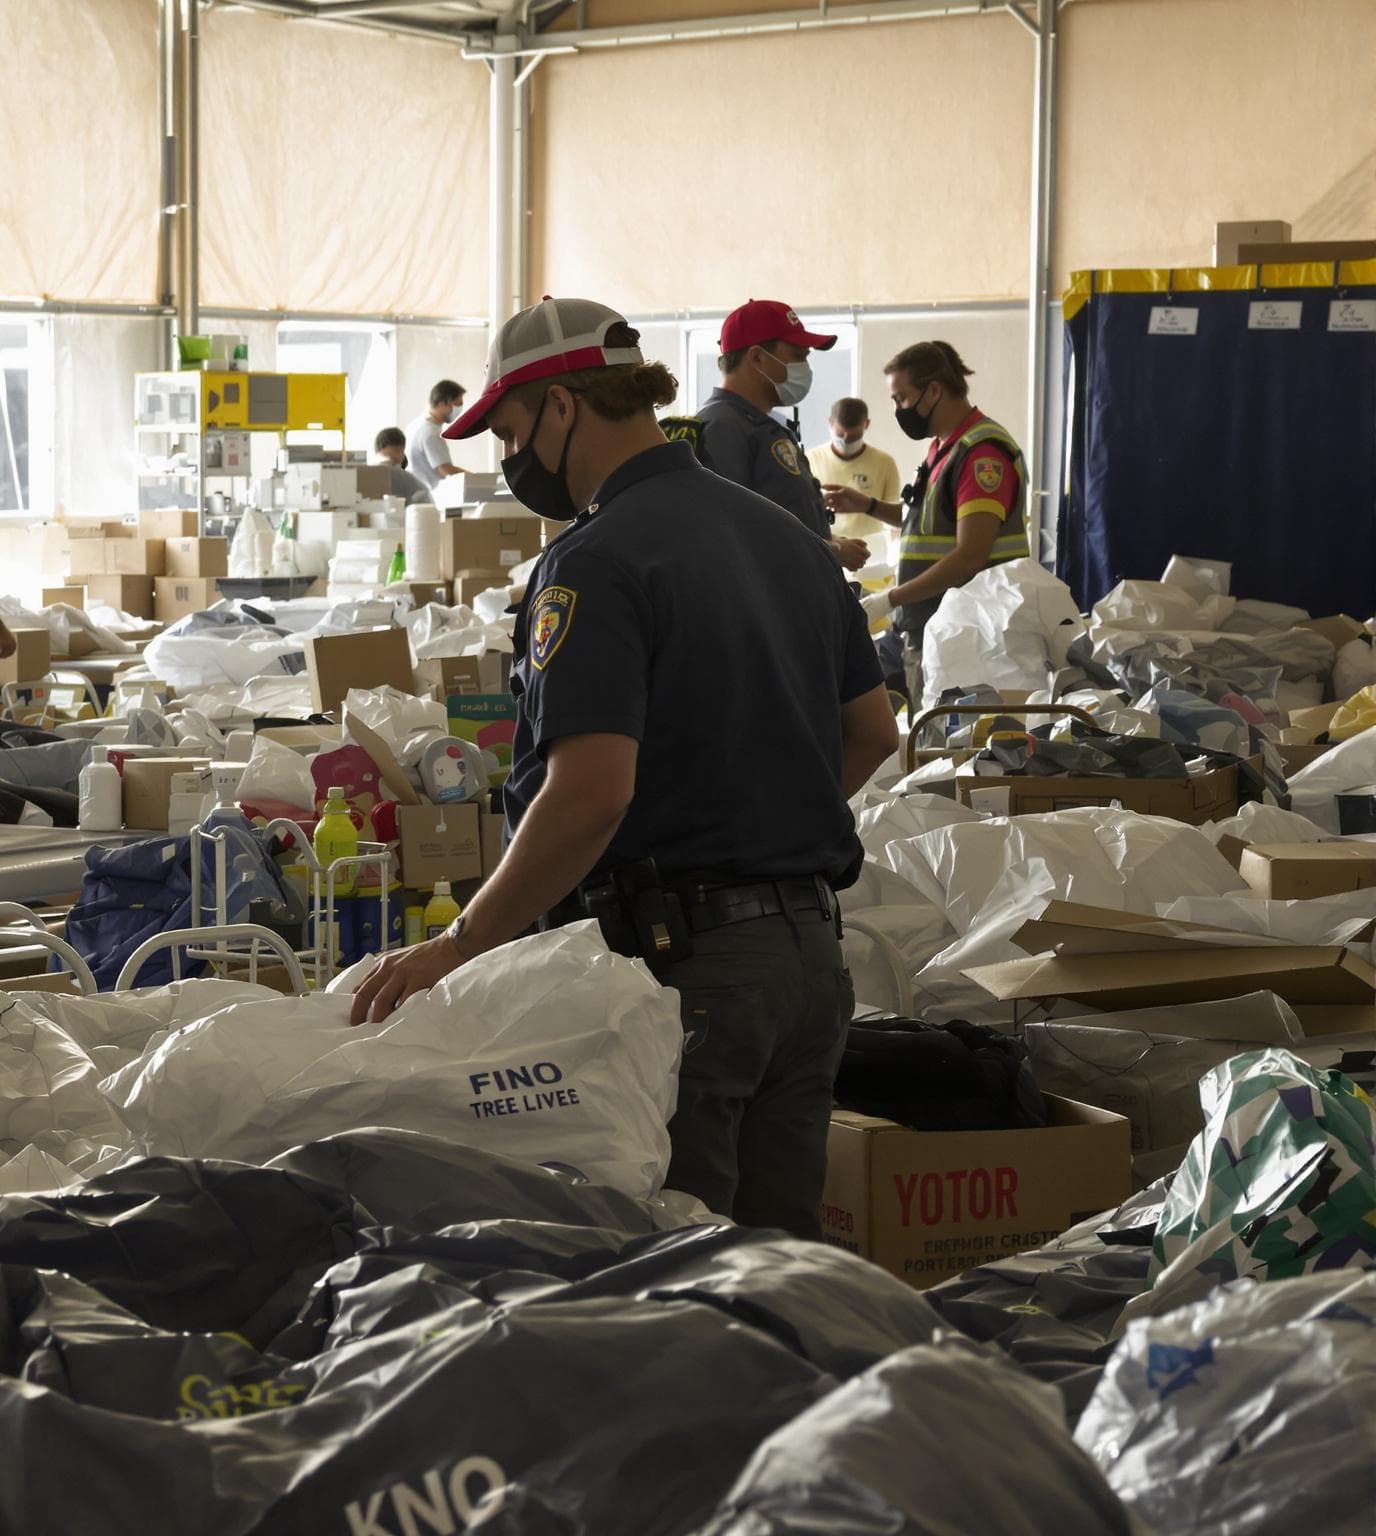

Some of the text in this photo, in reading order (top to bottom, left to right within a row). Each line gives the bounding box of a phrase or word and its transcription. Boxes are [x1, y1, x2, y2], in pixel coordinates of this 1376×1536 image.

[469, 1062, 562, 1095] FINO
[470, 1097, 519, 1119] TREE
[893, 1166, 1018, 1227] YOTOR
